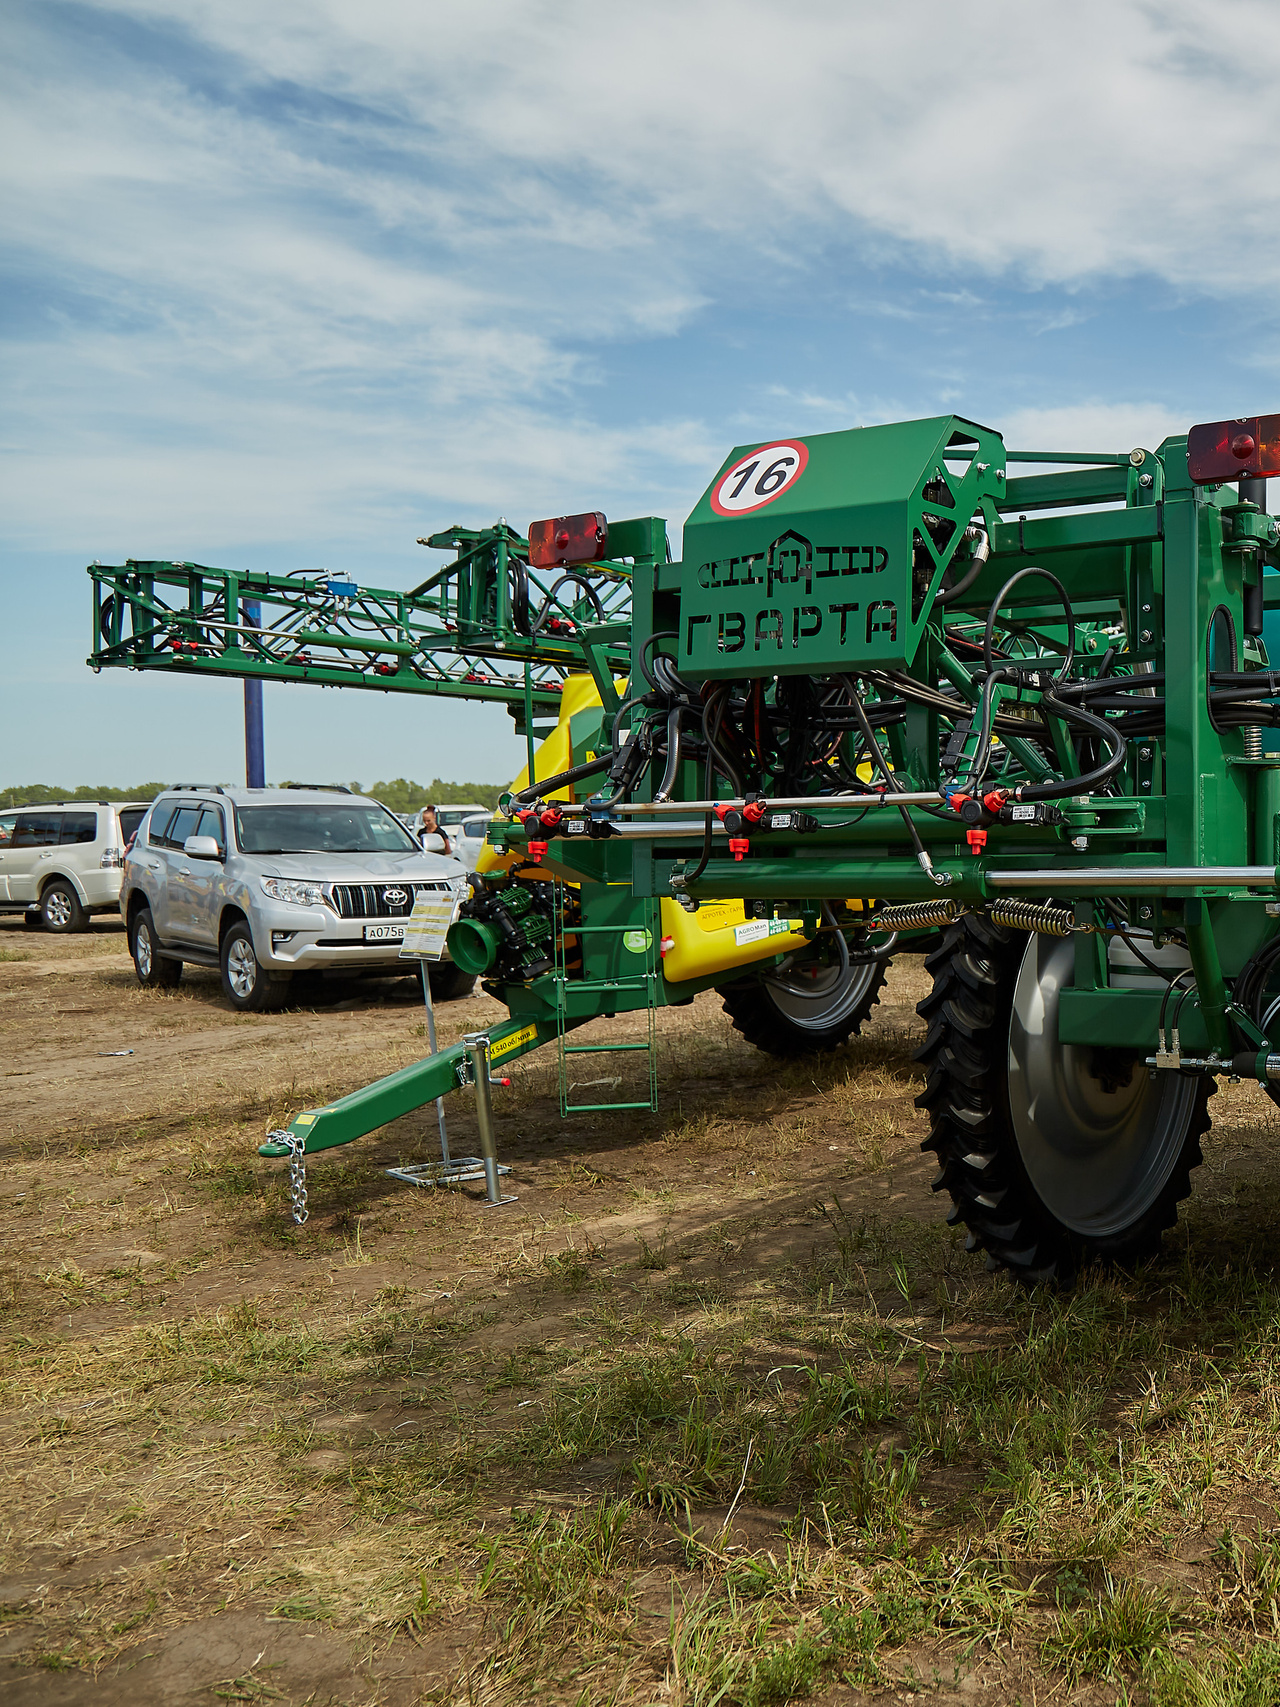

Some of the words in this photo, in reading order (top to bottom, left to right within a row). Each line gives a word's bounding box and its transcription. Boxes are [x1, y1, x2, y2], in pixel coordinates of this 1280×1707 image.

[729, 457, 795, 498] 16
[687, 600, 898, 656] ГВАРТА
[701, 910, 726, 920] АГРОТЕХ
[370, 927, 404, 938] А075В
